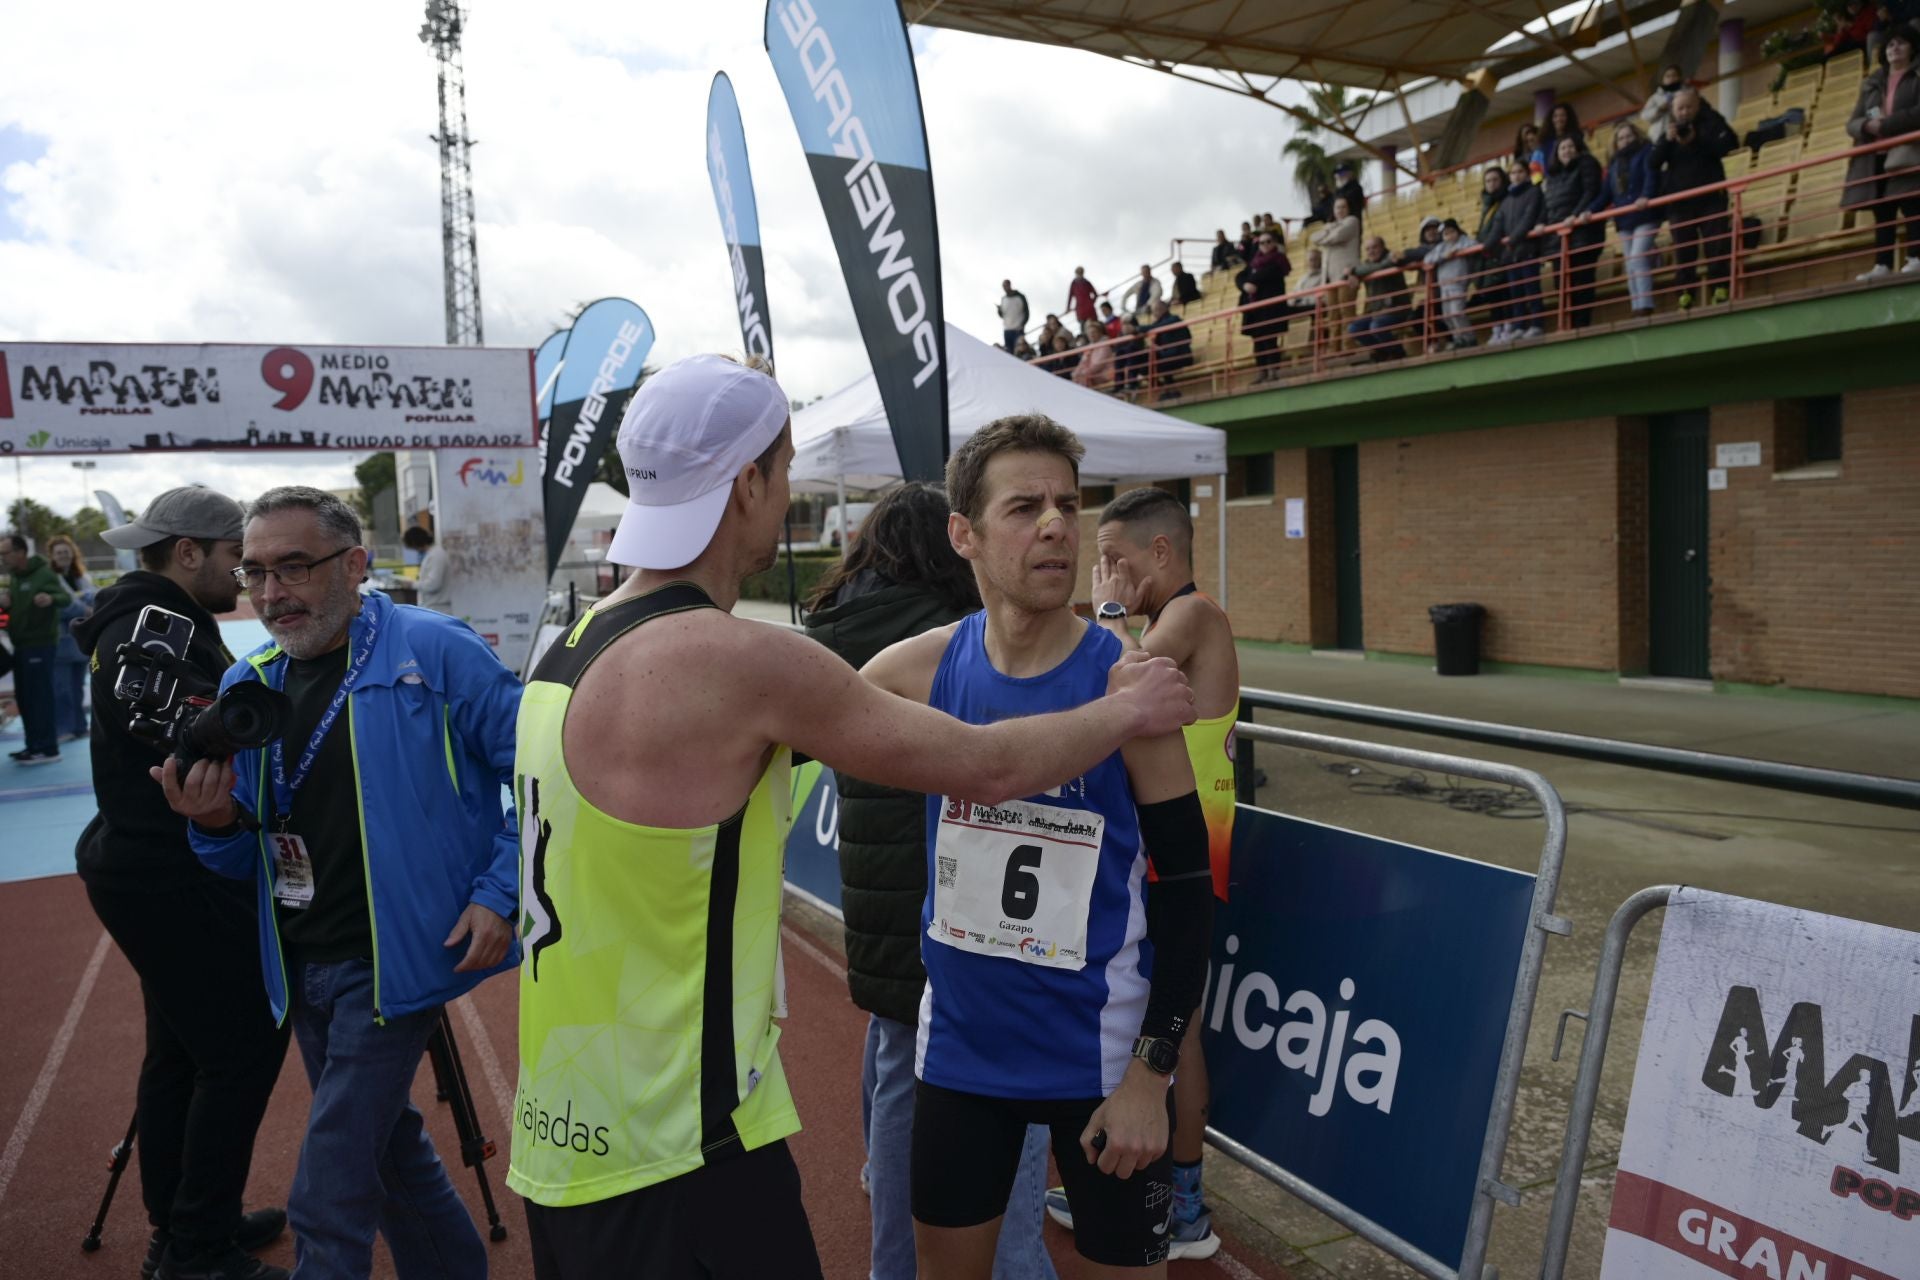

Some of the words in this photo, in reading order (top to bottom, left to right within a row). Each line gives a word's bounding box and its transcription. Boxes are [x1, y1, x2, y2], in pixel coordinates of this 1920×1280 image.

[320, 355, 389, 370] MEDIO
[261, 347, 314, 411] 9
[80, 407, 152, 415] POPULAR
[554, 319, 644, 488] POWERADE
[55, 437, 111, 448] Unicaja
[336, 436, 404, 448] CIUDAD
[412, 436, 433, 447] DE
[440, 435, 523, 447] BADAJOZ
[276, 836, 302, 860] 31
[1001, 844, 1043, 921] 6
[999, 920, 1033, 934] Gazapo
[1200, 934, 1402, 1118] icaja
[1702, 985, 1920, 1175] MA
